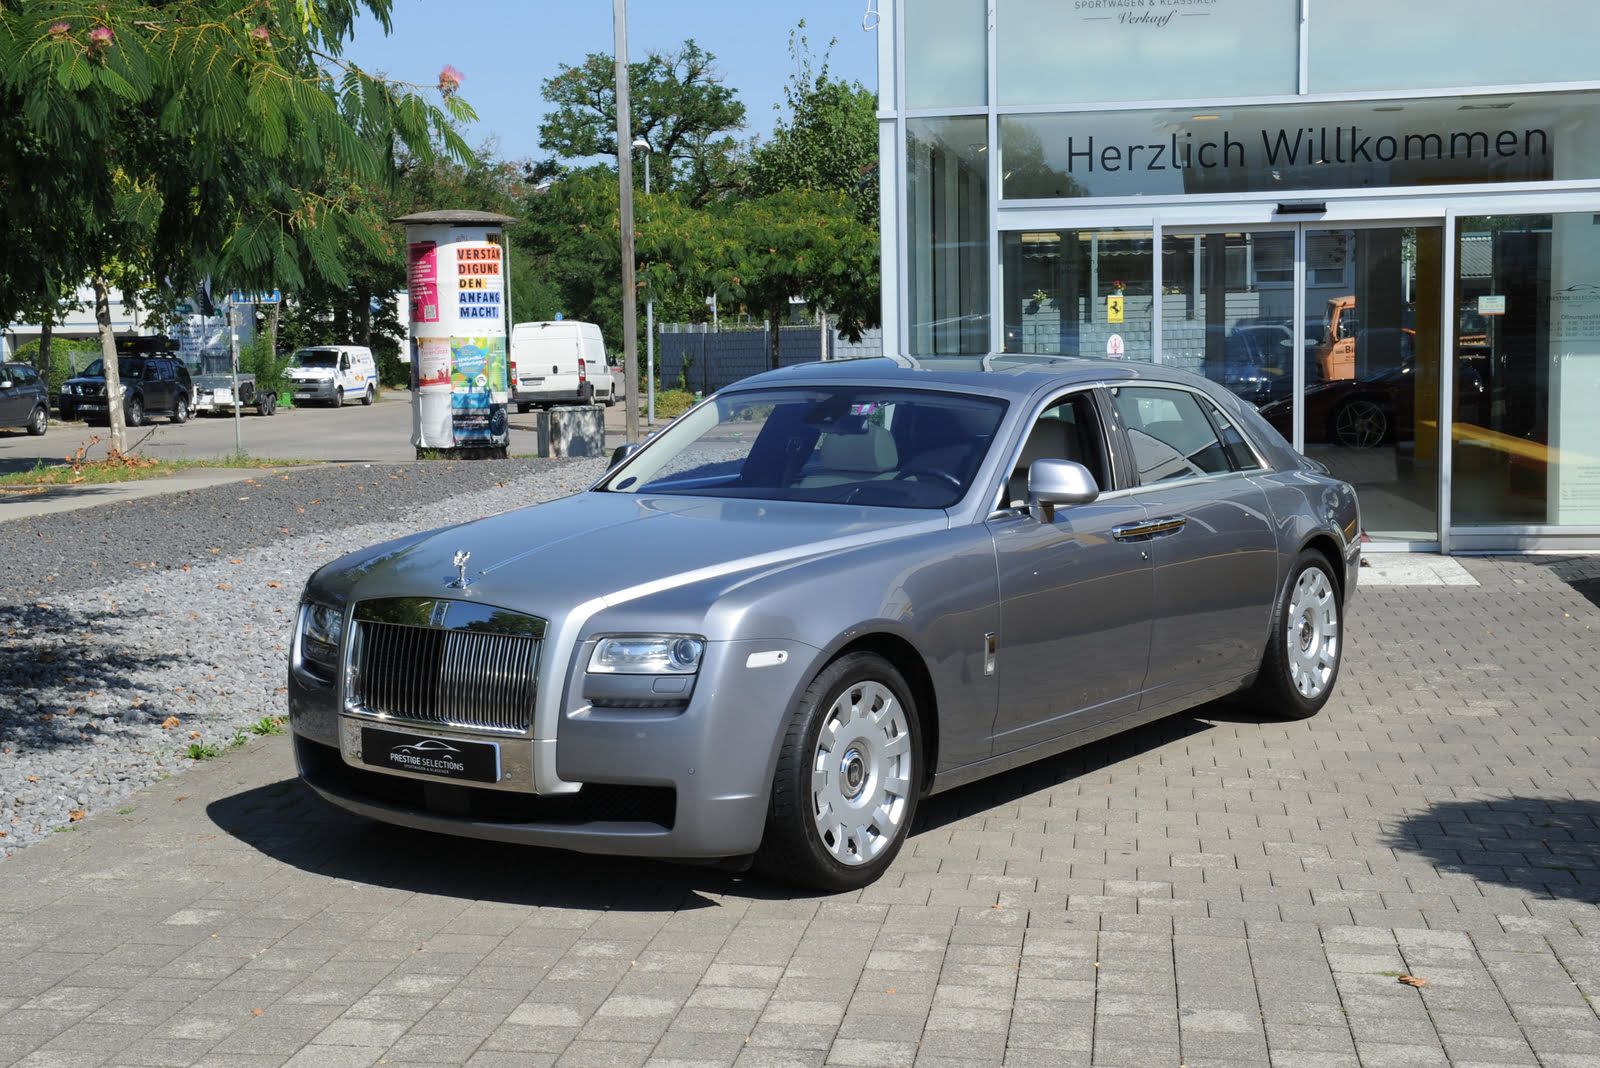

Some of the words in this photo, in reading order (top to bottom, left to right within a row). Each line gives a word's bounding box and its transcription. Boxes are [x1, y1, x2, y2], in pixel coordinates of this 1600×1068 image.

[1074, 0, 1144, 9] SPORTWAGEN
[1118, 9, 1178, 27] Verkauf
[1067, 130, 1246, 173] Herzlich
[1261, 126, 1548, 167] Willkommen
[458, 263, 498, 274] DIGUNG
[460, 278, 482, 288] DEN
[460, 292, 500, 303] ANFANG
[390, 753, 421, 765] PRESTIGE
[421, 758, 464, 771] SELECTIONS
